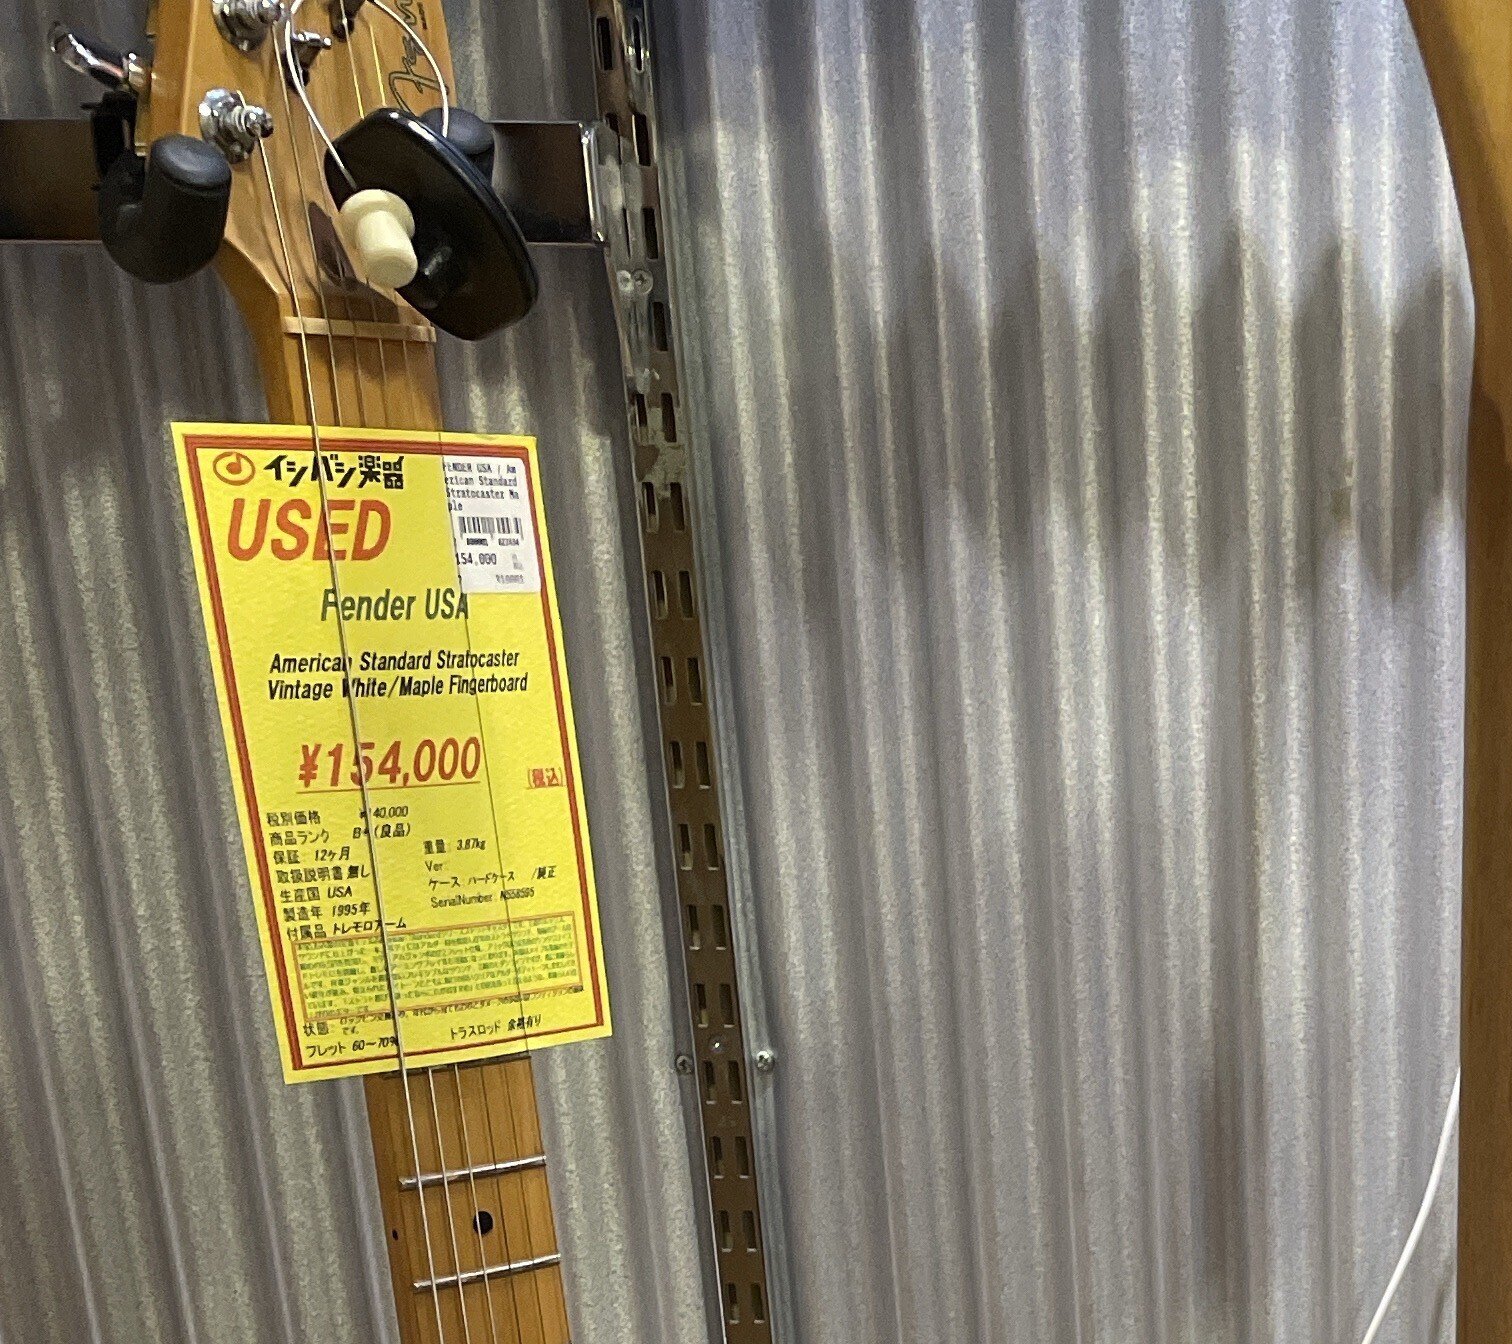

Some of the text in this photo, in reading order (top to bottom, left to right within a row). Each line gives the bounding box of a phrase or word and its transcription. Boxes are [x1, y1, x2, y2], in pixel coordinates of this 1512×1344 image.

[264, 454, 404, 490] イシバシ楽器
[227, 498, 391, 562] USED
[321, 588, 469, 621] Fender USA
[269, 649, 520, 674] American Standard Stratocaster
[267, 673, 528, 701] Vintage White/Maple Fingerboard
[298, 736, 481, 788] ¥154,000
[269, 829, 330, 846] 商品ランク
[280, 886, 353, 903] 生産国 USA
[283, 902, 371, 922] 製造年 1995年
[286, 917, 407, 941] 付属品 トレモロアーム
[451, 1021, 501, 1040] トラスロッド
[306, 1042, 346, 1058] フレット
